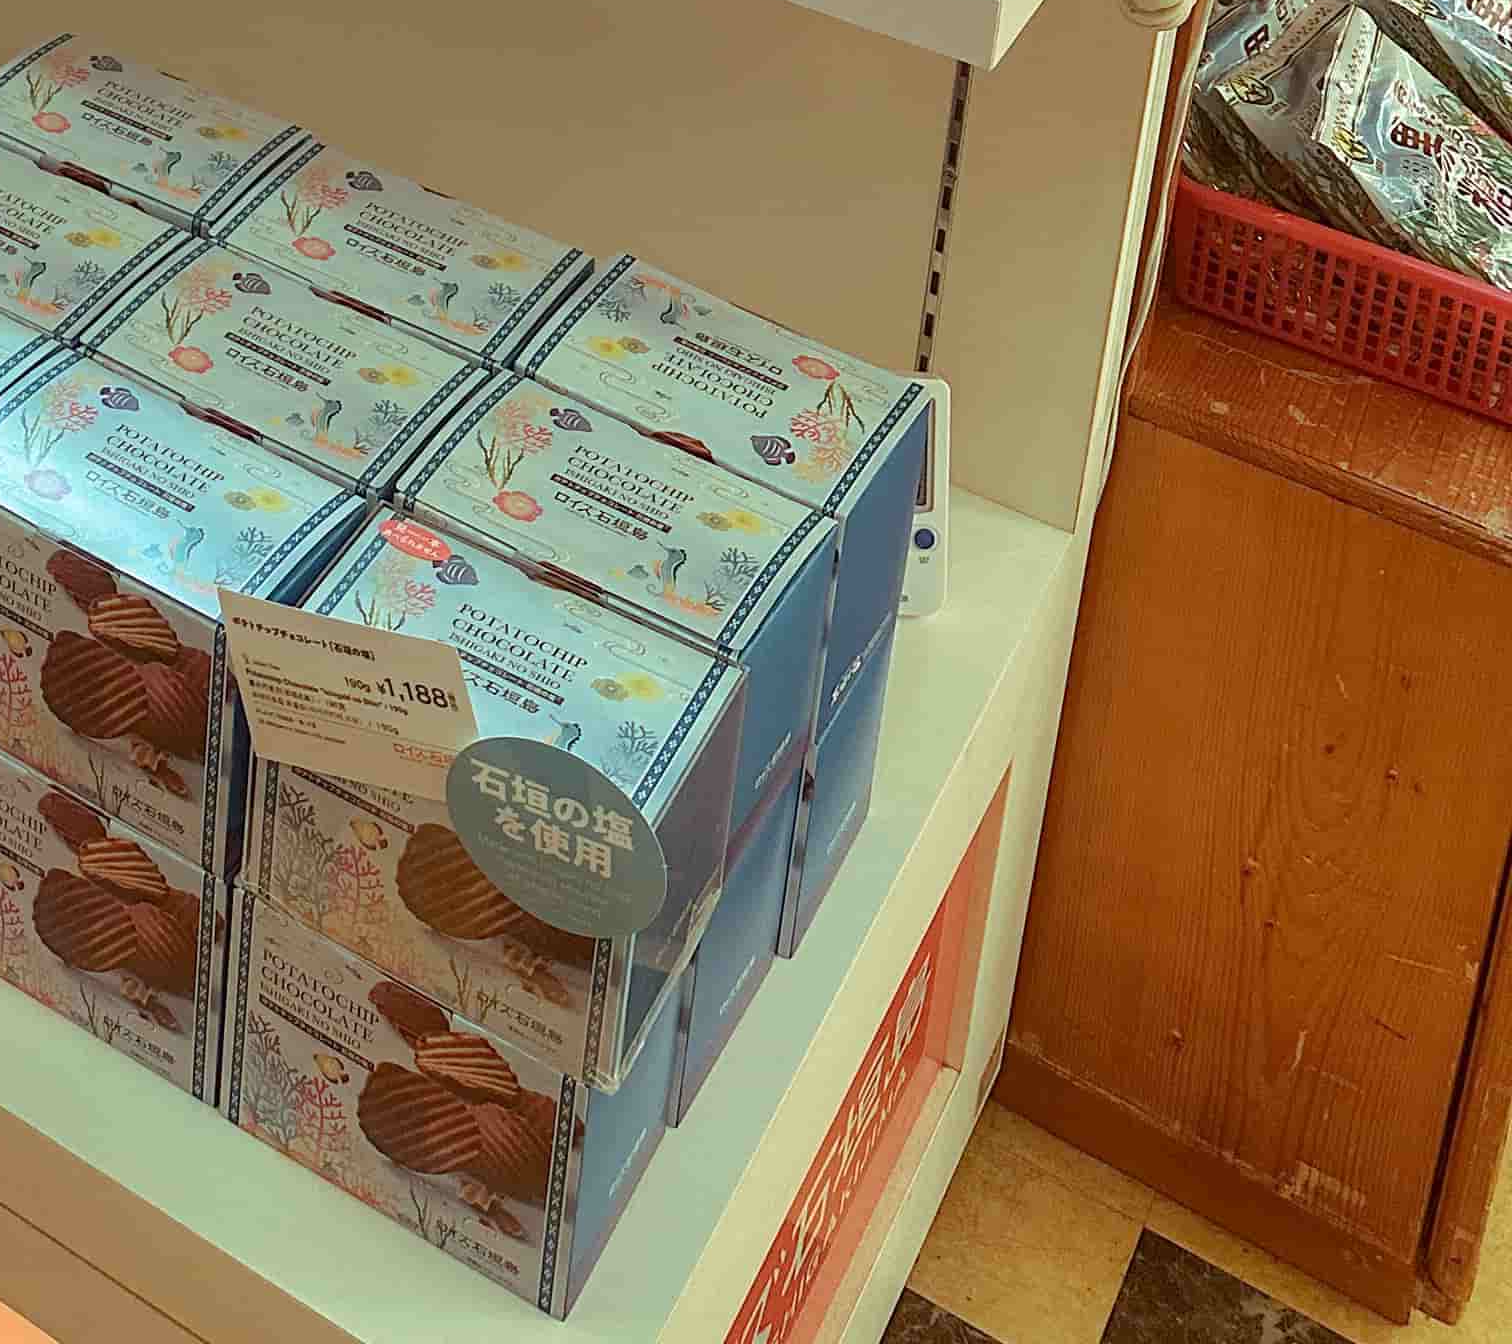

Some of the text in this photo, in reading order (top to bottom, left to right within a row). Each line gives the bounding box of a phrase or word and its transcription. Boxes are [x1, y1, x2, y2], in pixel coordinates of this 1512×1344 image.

[357, 210, 455, 256] CHOCOLATE
[363, 201, 469, 247] POTATOCHIP
[241, 315, 344, 369] CHOCOLATE
[249, 306, 359, 360] POTATOCHIP
[225, 349, 310, 393] ロイズ石垣島
[651, 361, 768, 419] POTATOCHIP
[664, 352, 775, 408] CHOCOLATE
[105, 435, 210, 494] CHOCOLATE
[116, 422, 225, 482] POTATOCHIP
[574, 445, 695, 503] POTATOCHIP
[566, 456, 683, 514] CHOCOLATE
[555, 491, 649, 541] ロイズ石垣島
[450, 618, 574, 684] CHOCOLATE
[457, 602, 588, 669] POTATOCHIP
[463, 669, 541, 714] ズ石垣島
[470, 757, 634, 850] 石垣の塩
[495, 806, 612, 879] を使用
[261, 967, 373, 1042] CHOCOLATE
[262, 949, 379, 1026] POTATOCHIP
